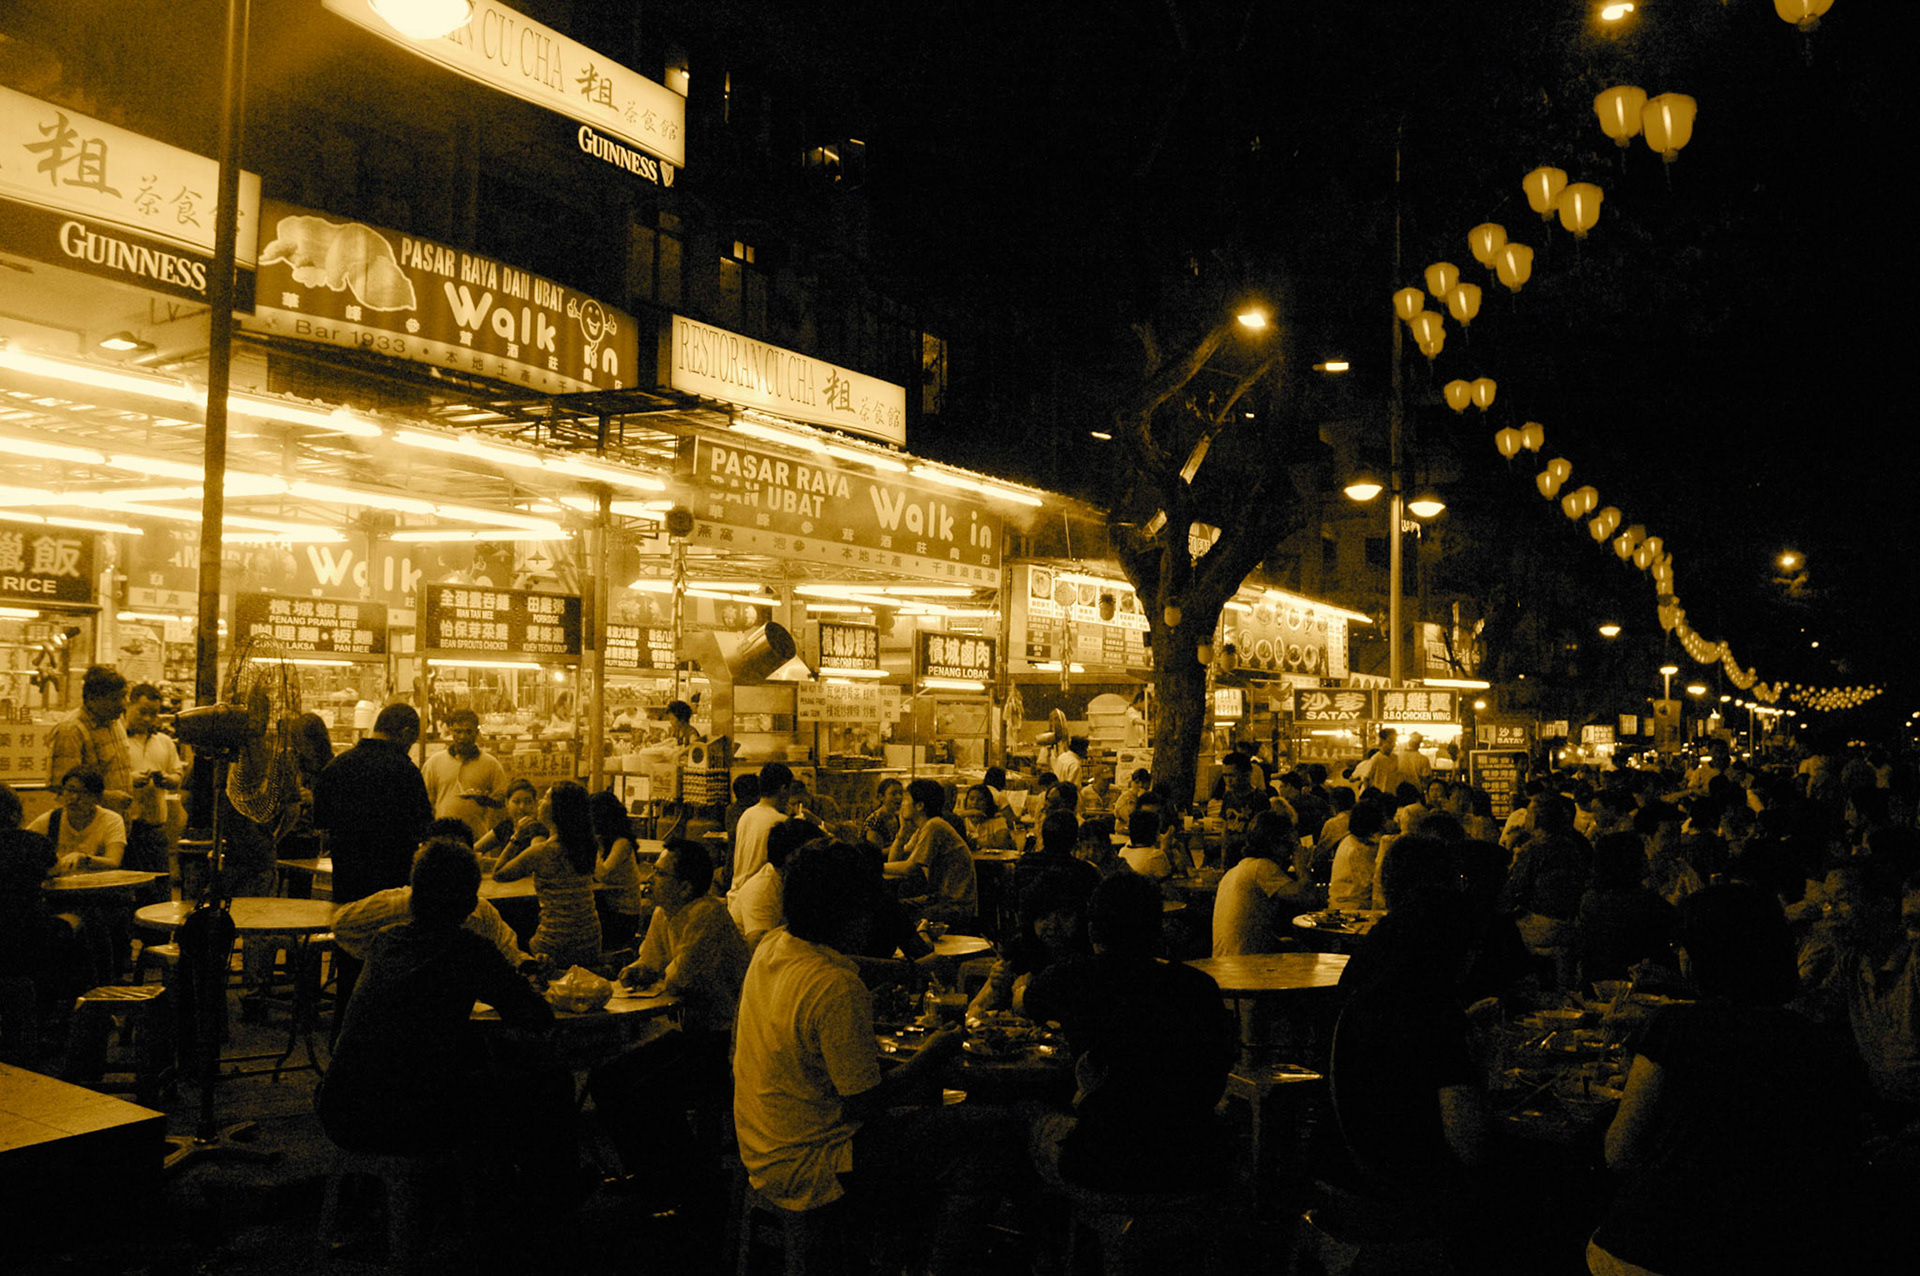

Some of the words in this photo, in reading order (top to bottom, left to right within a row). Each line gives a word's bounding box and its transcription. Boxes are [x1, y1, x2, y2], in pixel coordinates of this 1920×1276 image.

[483, 8, 514, 67] CU
[520, 27, 564, 93] CHA
[578, 125, 658, 184] GUINNESS
[60, 221, 207, 291] GUINNESS
[401, 237, 455, 278] PASAR
[461, 253, 498, 291] RAYA
[503, 267, 530, 301] DAN
[534, 278, 565, 313] UBAT
[444, 281, 556, 353] Walk
[295, 319, 340, 341] Bar
[351, 330, 407, 354] 1933
[678, 320, 762, 390] RESTORAN
[766, 348, 783, 397] CU
[787, 355, 816, 407] CHA
[711, 447, 790, 487] PASAR
[797, 465, 850, 500] RAYA
[768, 488, 825, 519] UBAT
[870, 484, 955, 542] Walk
[970, 510, 992, 549] in
[3, 576, 57, 594] RICE
[269, 615, 306, 625] PENANG
[307, 617, 338, 627] PRAWN
[340, 620, 357, 629] MEE
[456, 608, 469, 618] WAN
[470, 610, 482, 619] TAN
[482, 610, 494, 620] MEE
[286, 641, 315, 651] LAKSA
[334, 644, 351, 652] PAN
[440, 639, 456, 649] BEAN
[457, 640, 482, 650] SPROUTS
[483, 641, 507, 651] CHICKEN
[928, 665, 961, 678] PENANG
[963, 668, 989, 680] LOBAK
[1306, 711, 1360, 720] SATAY
[1403, 711, 1431, 721] CHICKEN
[1432, 711, 1451, 721] WING
